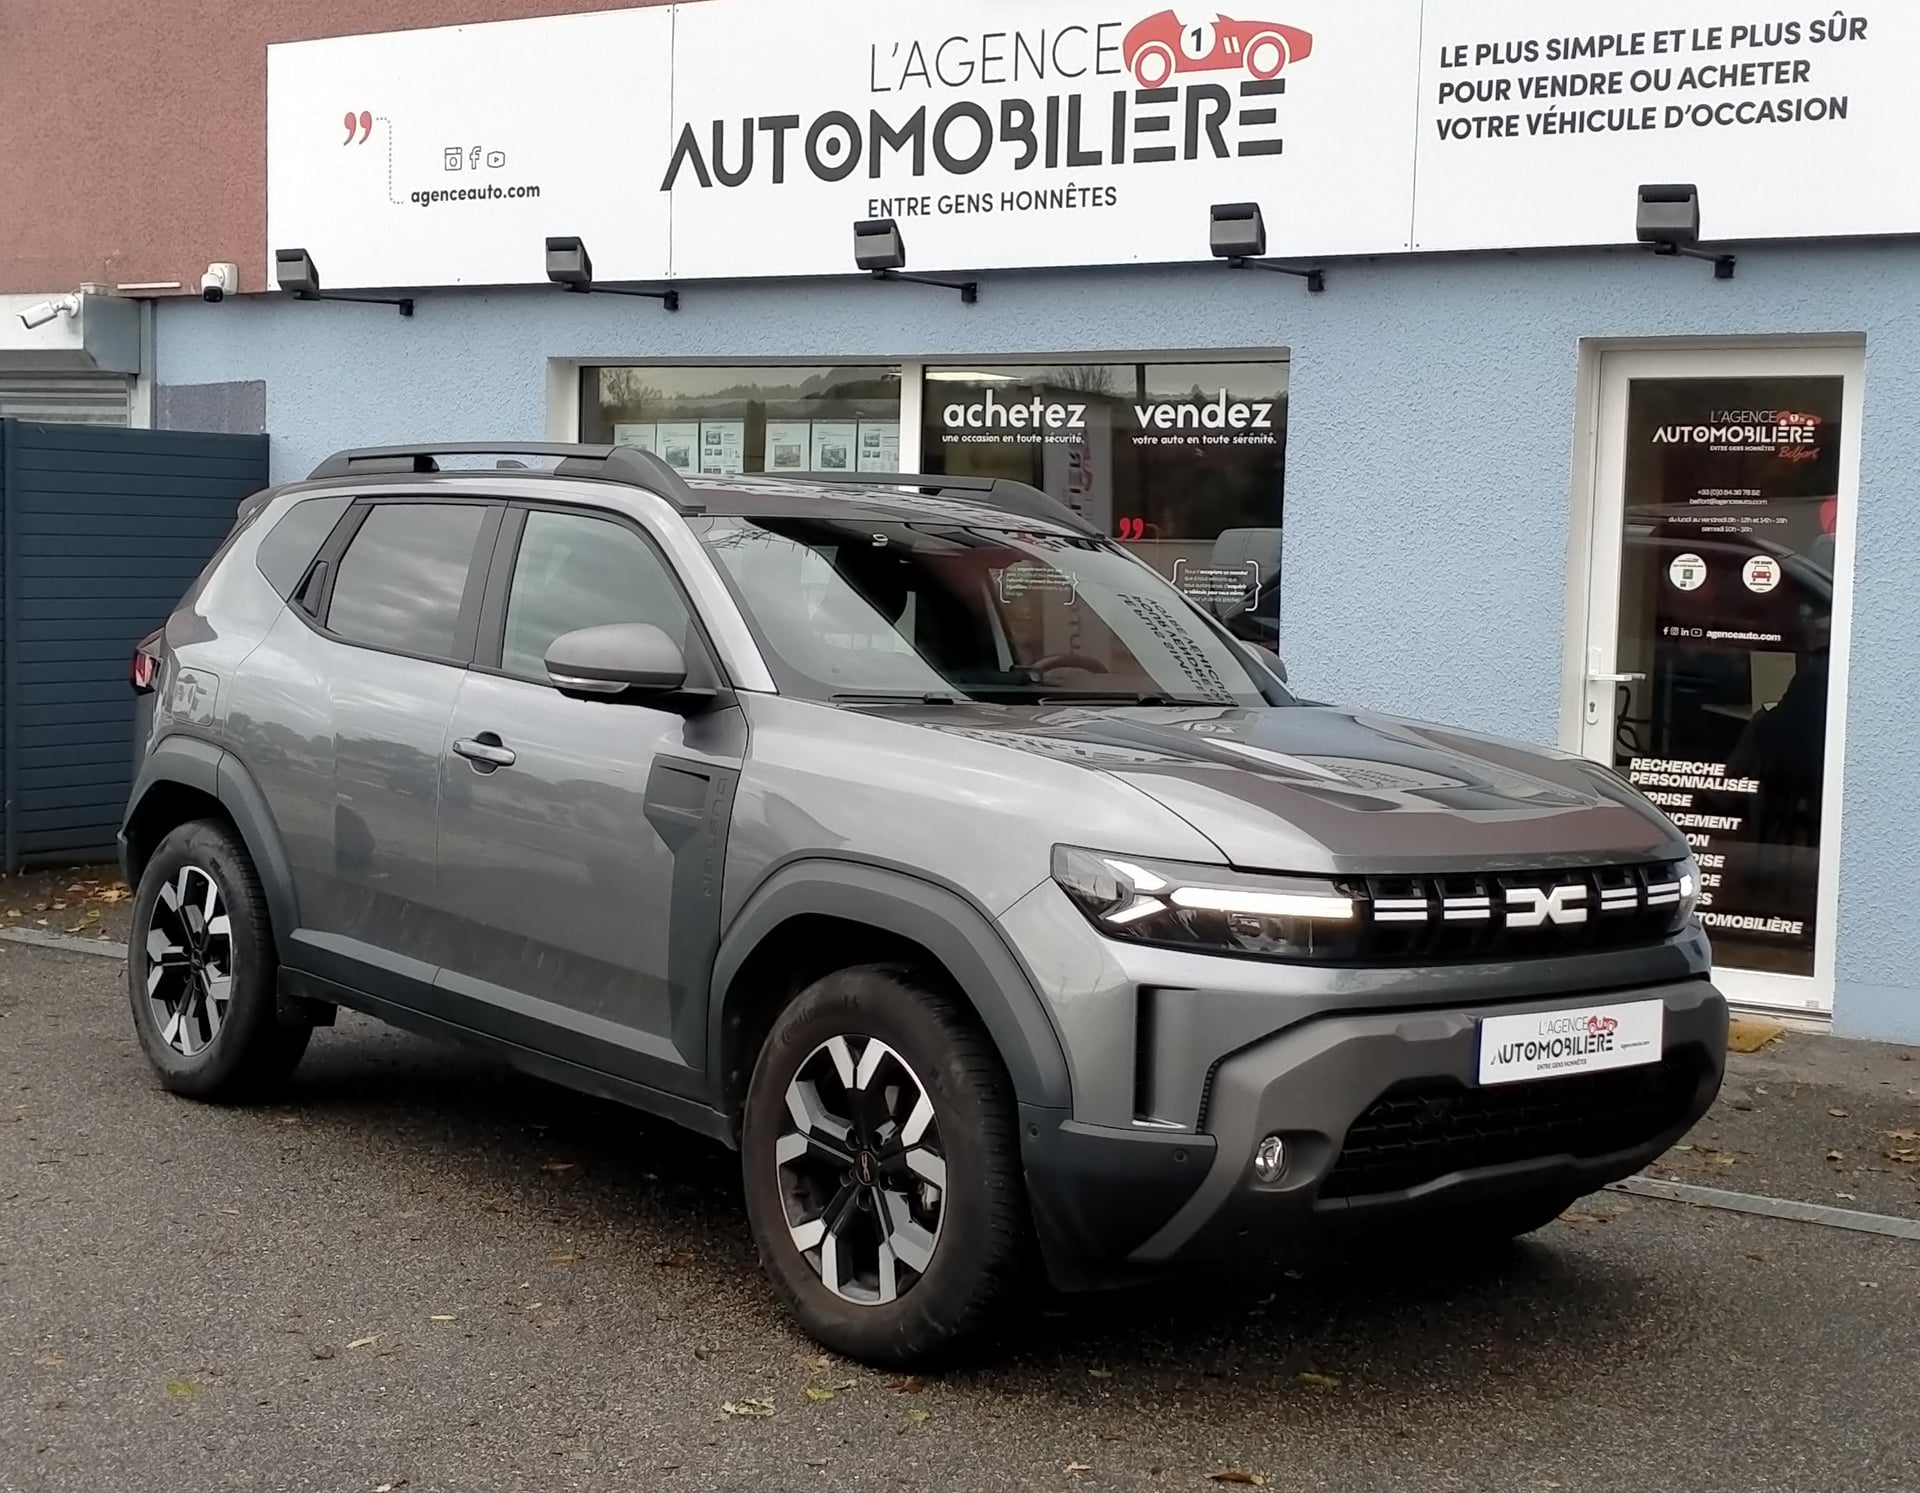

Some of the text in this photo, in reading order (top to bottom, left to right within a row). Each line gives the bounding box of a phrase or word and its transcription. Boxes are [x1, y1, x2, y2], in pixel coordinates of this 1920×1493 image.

[1440, 11, 1868, 68] LE PLUS SIMPLE ET LE PLUS SÛR
[870, 22, 1123, 93] L'AGENCE
[1438, 60, 1811, 104] POUR VENDRE OU ACHETER
[1436, 96, 1848, 140] VOTRE VÉHICULE D'OCCASION
[411, 184, 540, 206] agenceauto.com
[868, 184, 1117, 218] ENTRE GENS HONNÊTES
[943, 389, 1087, 428] achetez
[1134, 387, 1273, 428] vendez
[1710, 410, 1777, 423] L'AGENCE
[942, 432, 1085, 443] une occasion en toute sécurité.
[1132, 432, 1277, 445] votre auto en toute sérénité.
[1706, 630, 1781, 641] agenceauto.com
[1630, 757, 1726, 776] RECHERCHE
[1629, 772, 1759, 793] PERSONNALISÉE
[1538, 1016, 1588, 1035] L'AGENCE
